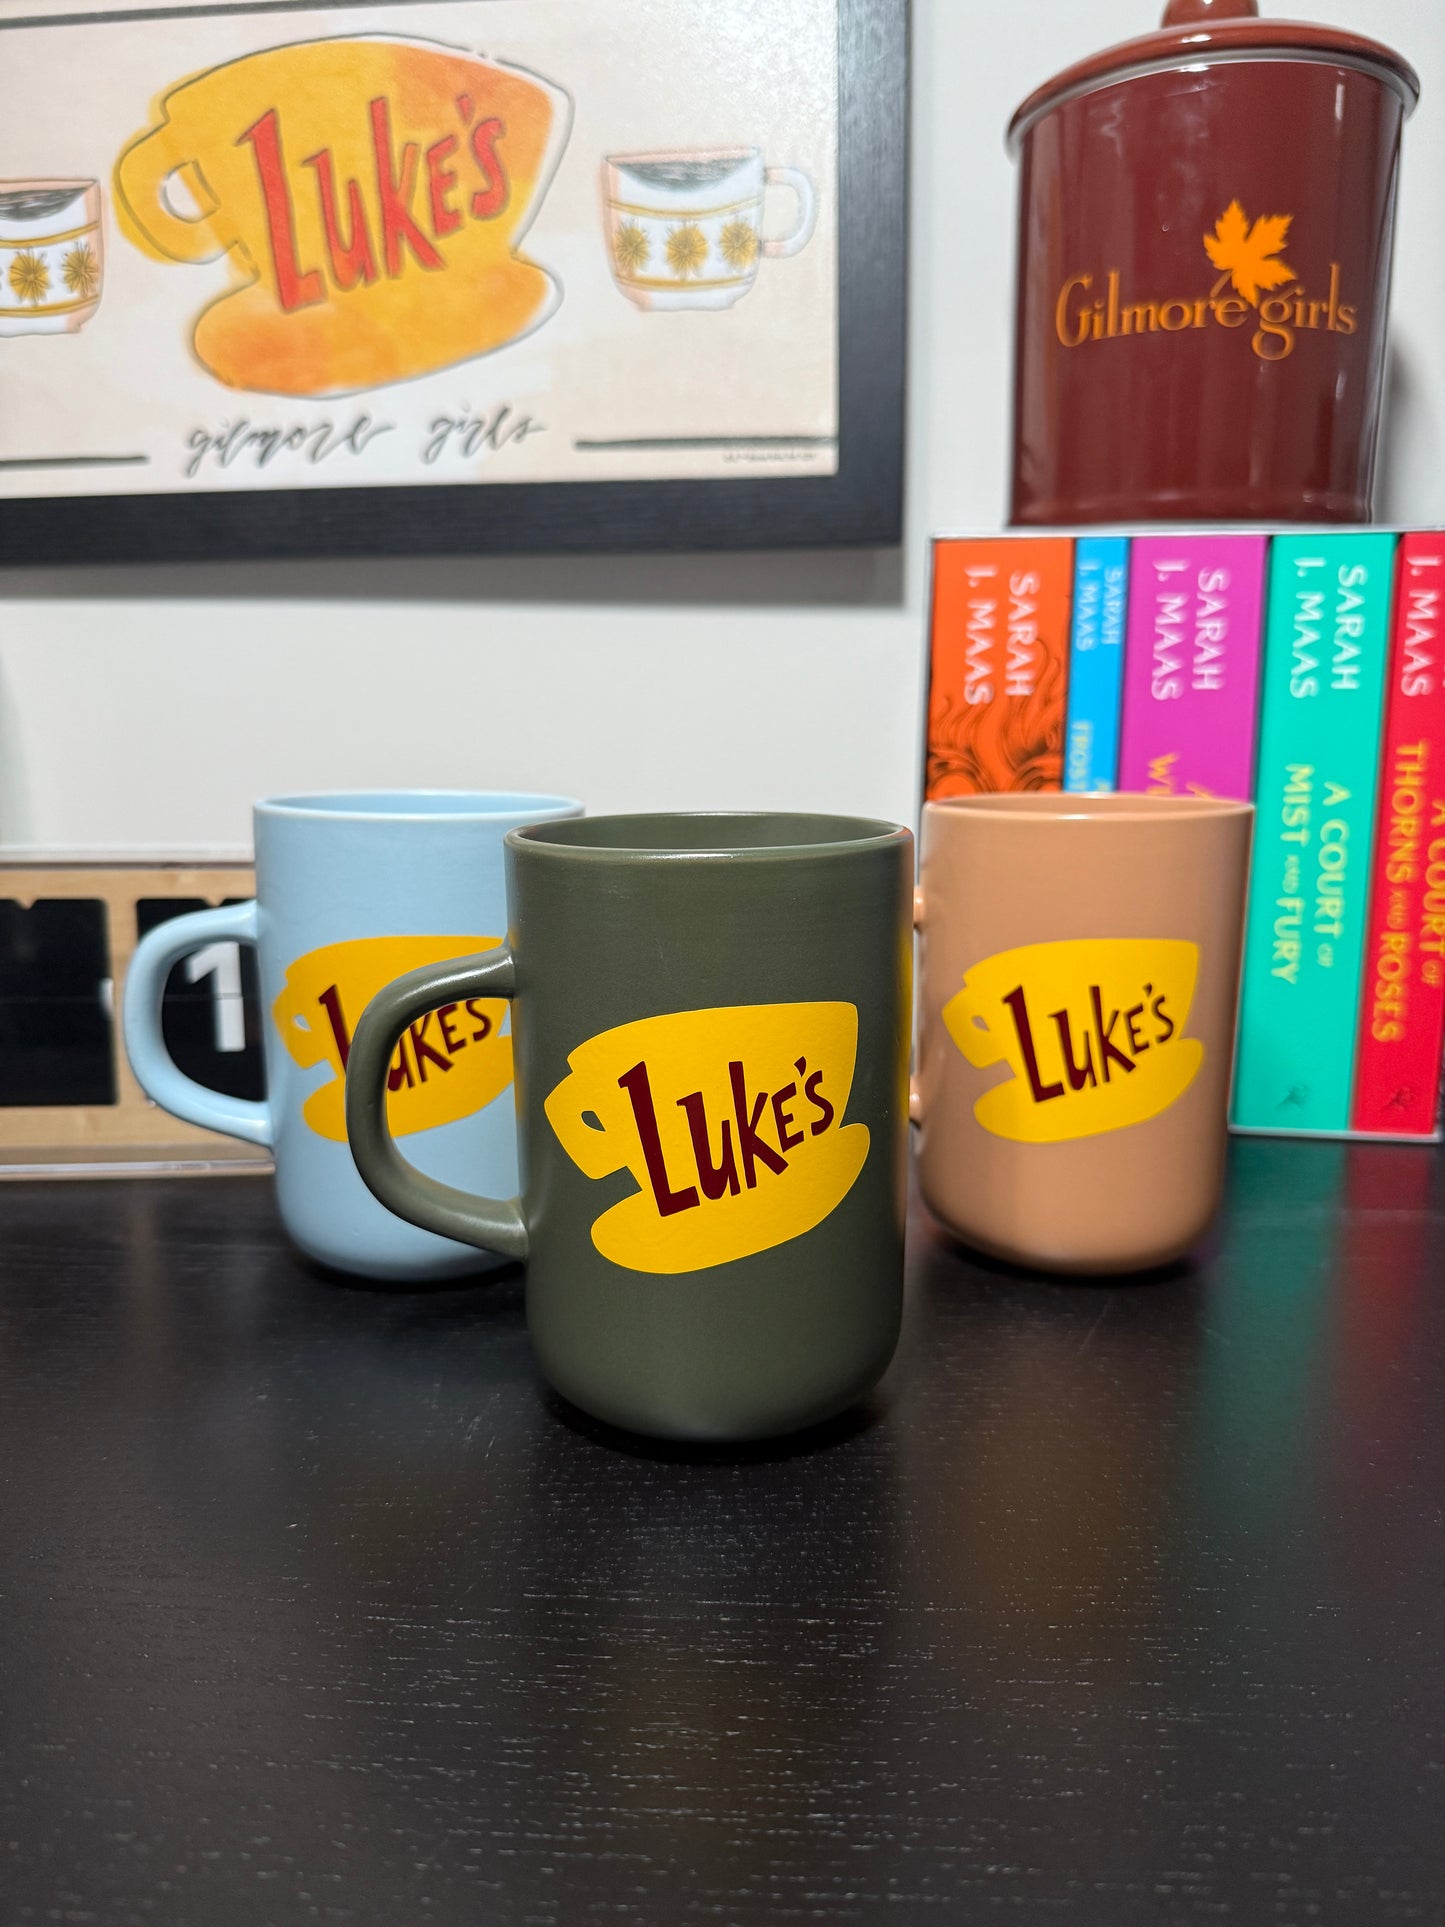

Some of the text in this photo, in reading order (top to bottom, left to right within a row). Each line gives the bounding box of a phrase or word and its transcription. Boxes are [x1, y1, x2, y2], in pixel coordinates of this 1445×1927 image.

[1056, 262, 1357, 360] Gilmore girls
[421, 403, 547, 464] girls
[964, 600, 996, 704] MAAS
[1006, 573, 1038, 695] SARAH
[1076, 582, 1098, 651] MAAS
[1102, 567, 1121, 645] SARAH
[1152, 595, 1186, 700] MAAS
[1192, 570, 1227, 689] SARAH
[1290, 592, 1324, 698] MAAS
[1331, 565, 1367, 689] SARAH
[1401, 590, 1438, 696] MAAS
[1281, 765, 1313, 845] MIST
[1324, 783, 1350, 805] A
[1387, 742, 1424, 884] THORNS
[1314, 819, 1348, 937] COURT
[1272, 898, 1304, 983] FURY
[1373, 932, 1408, 1041] ROSES
[188, 941, 245, 1052] 1
